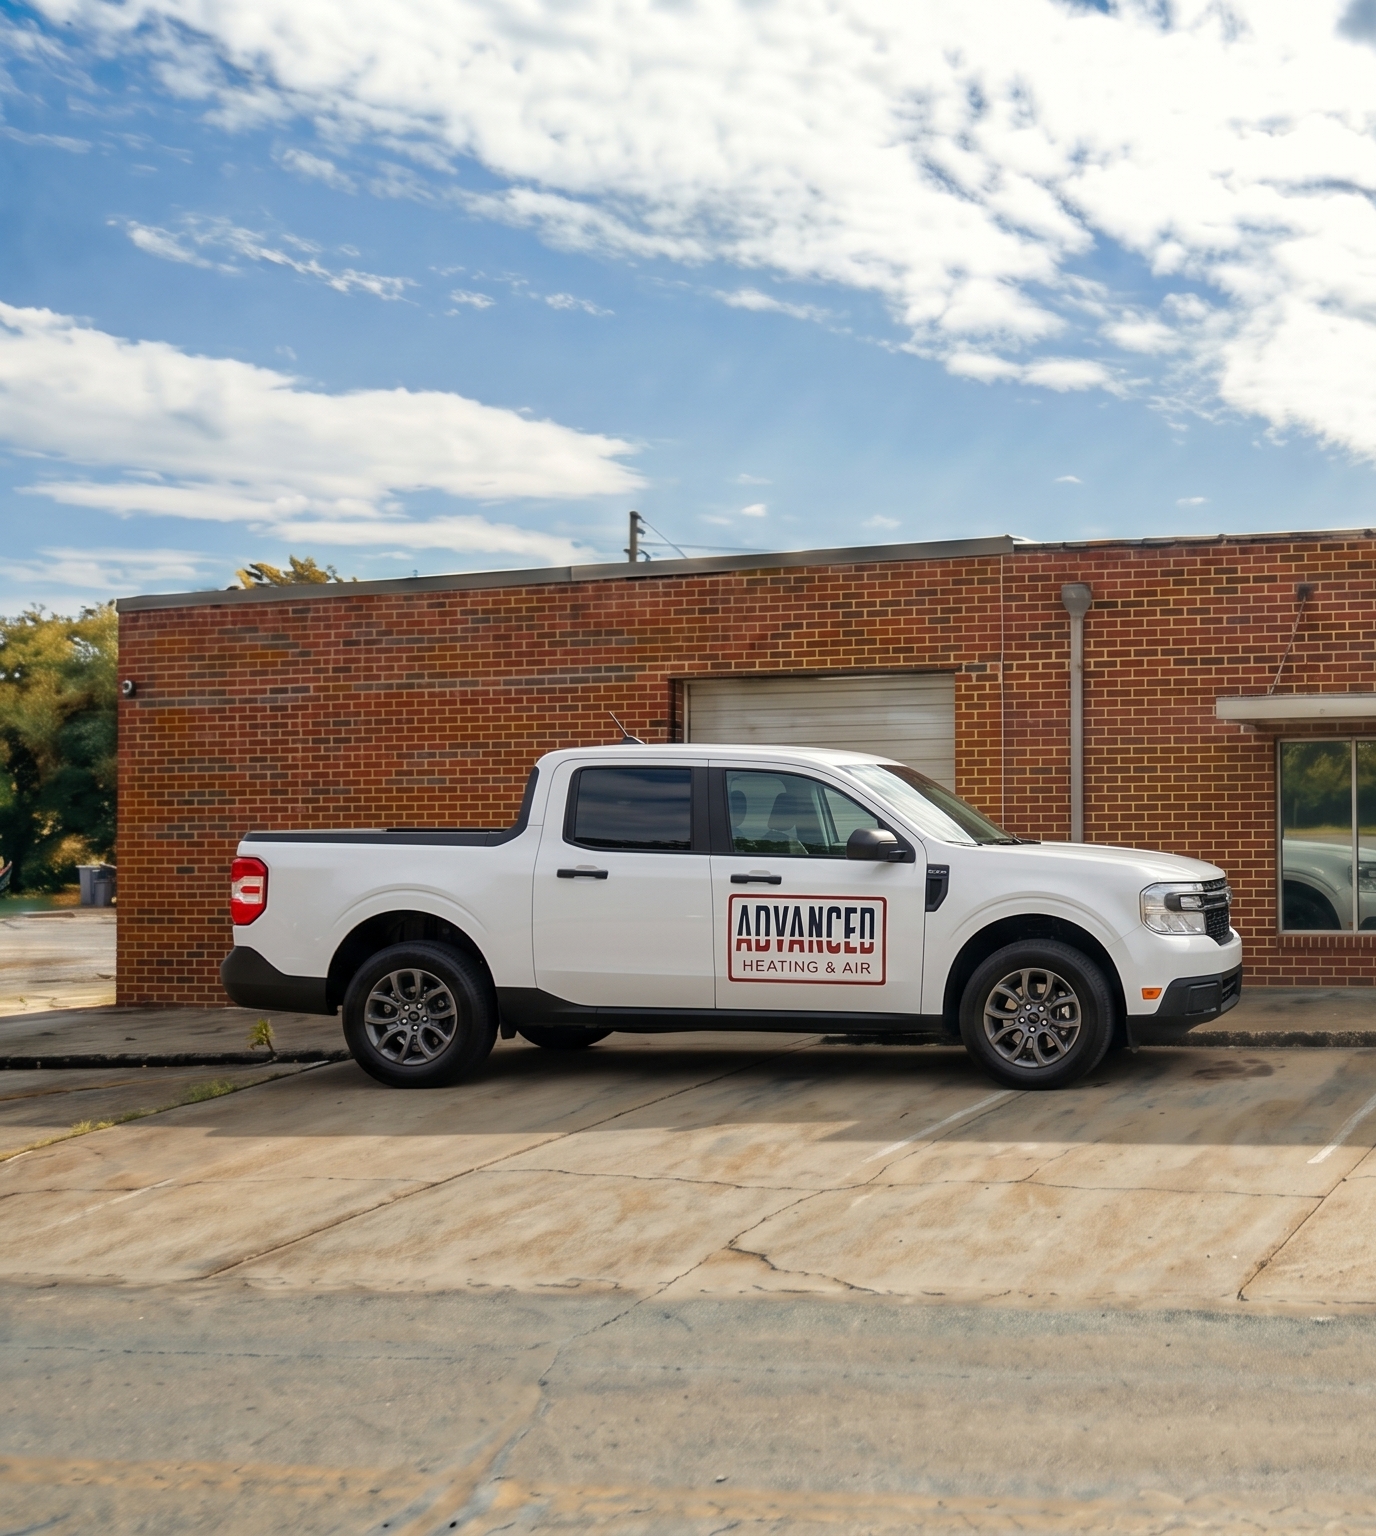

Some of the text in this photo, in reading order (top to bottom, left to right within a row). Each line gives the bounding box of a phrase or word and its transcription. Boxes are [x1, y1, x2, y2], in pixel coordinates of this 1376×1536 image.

[736, 905, 875, 954] ADVANCED
[743, 960, 871, 974] HEATING & AIR
